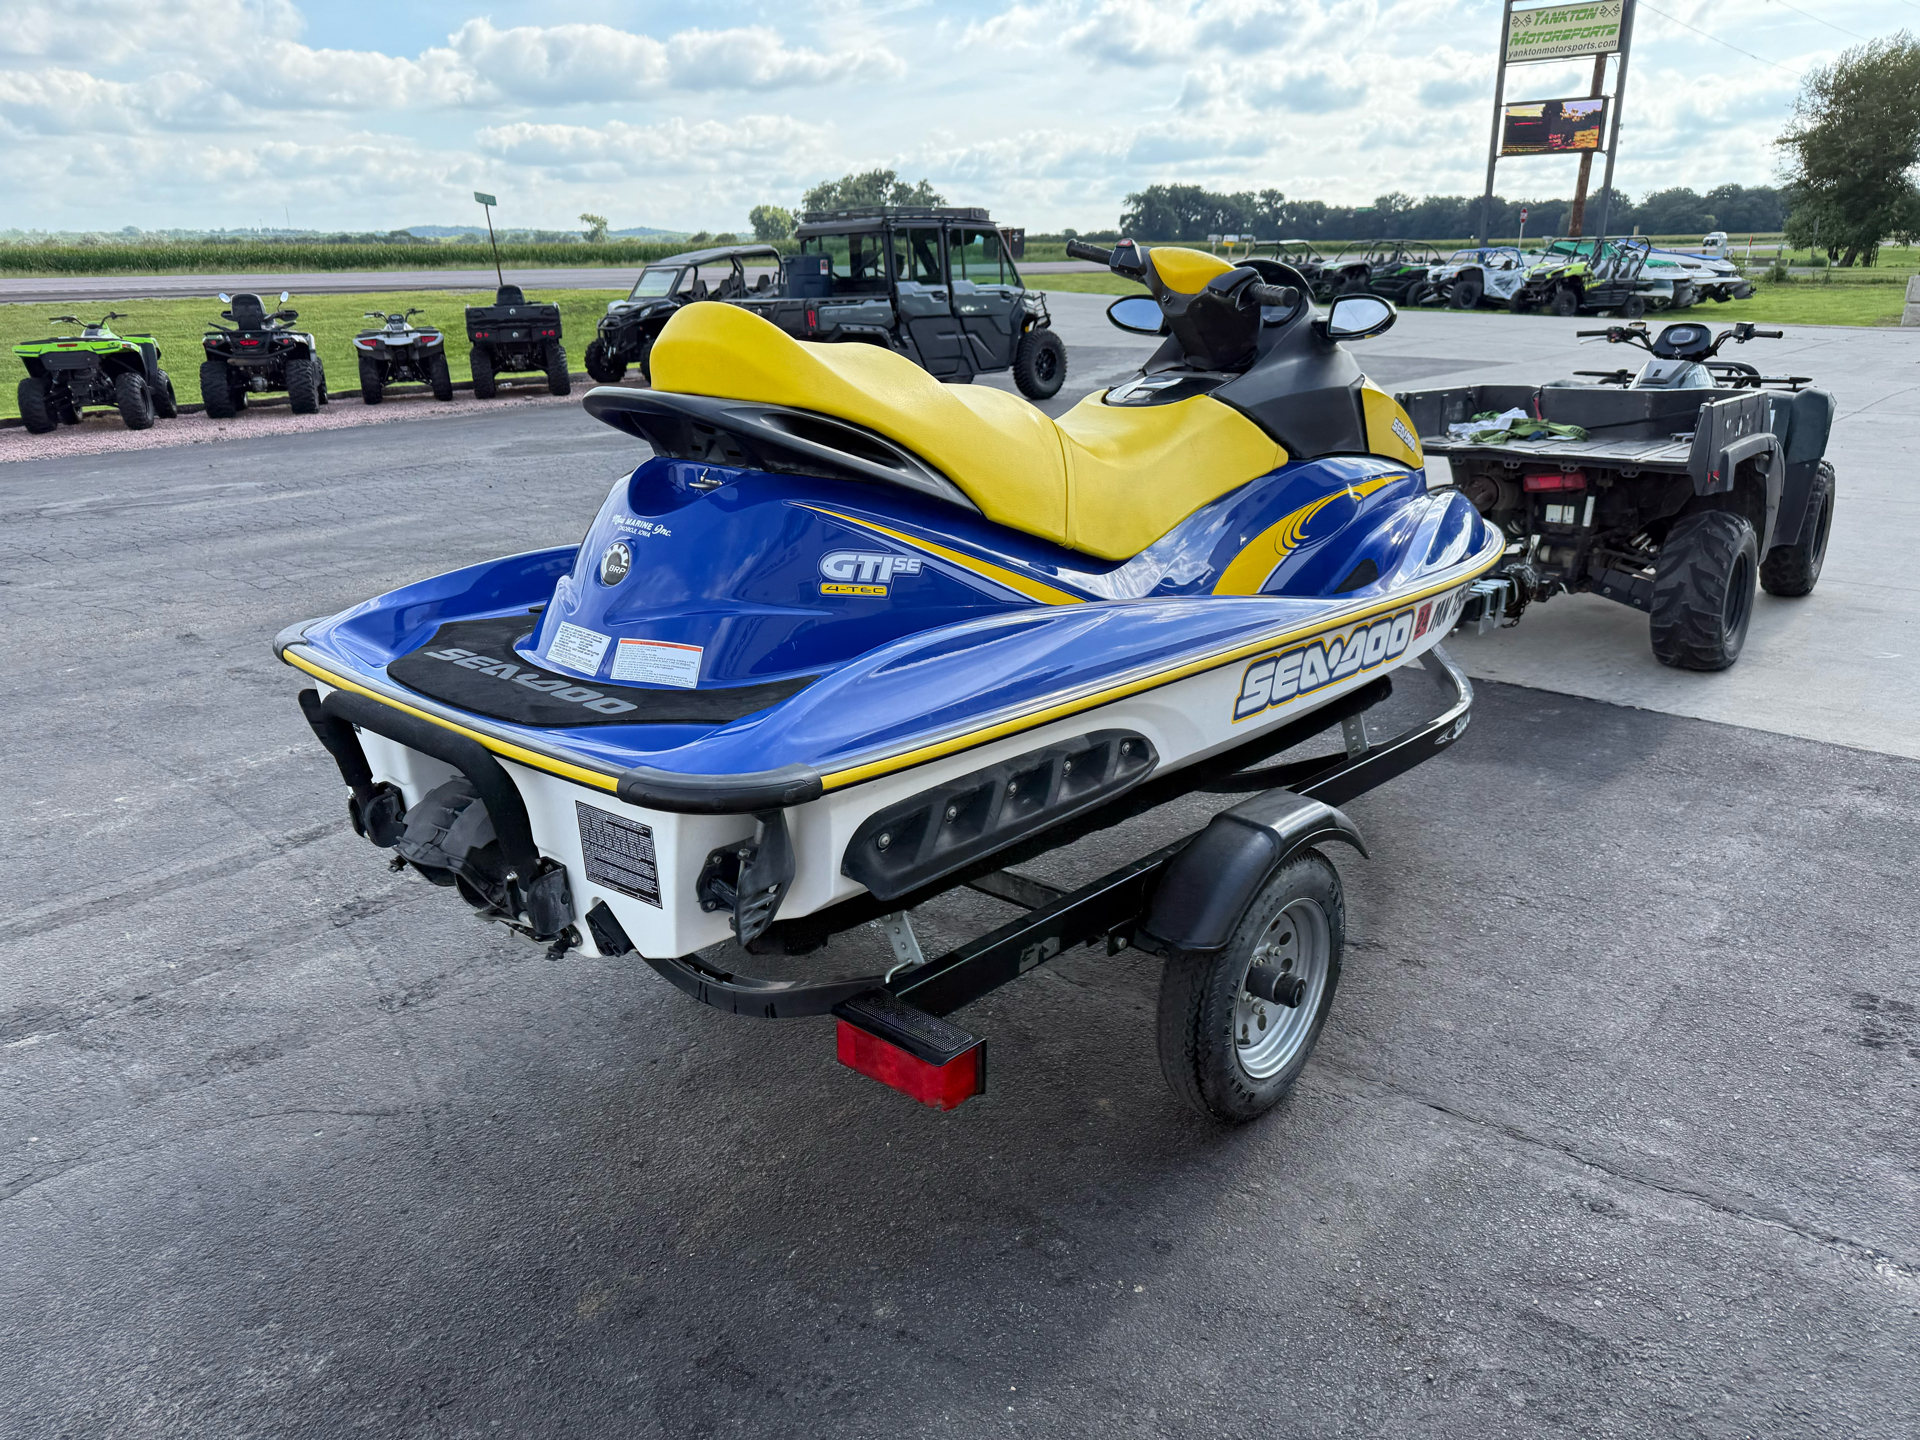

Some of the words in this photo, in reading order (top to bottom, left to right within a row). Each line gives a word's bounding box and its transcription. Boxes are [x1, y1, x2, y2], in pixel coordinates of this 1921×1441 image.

[1534, 7, 1599, 26] YANKTON
[1509, 23, 1619, 46] MOTORSPORTS
[1508, 38, 1617, 59] yanktonmotorsports.com
[625, 518, 654, 531] MARINE
[652, 524, 672, 537] Inc.
[637, 529, 651, 538] IOWA
[608, 564, 627, 575] BRP
[822, 554, 894, 580] GTI
[892, 557, 921, 572] SE
[824, 585, 884, 594] 4-TEC
[1415, 608, 1431, 635] 24
